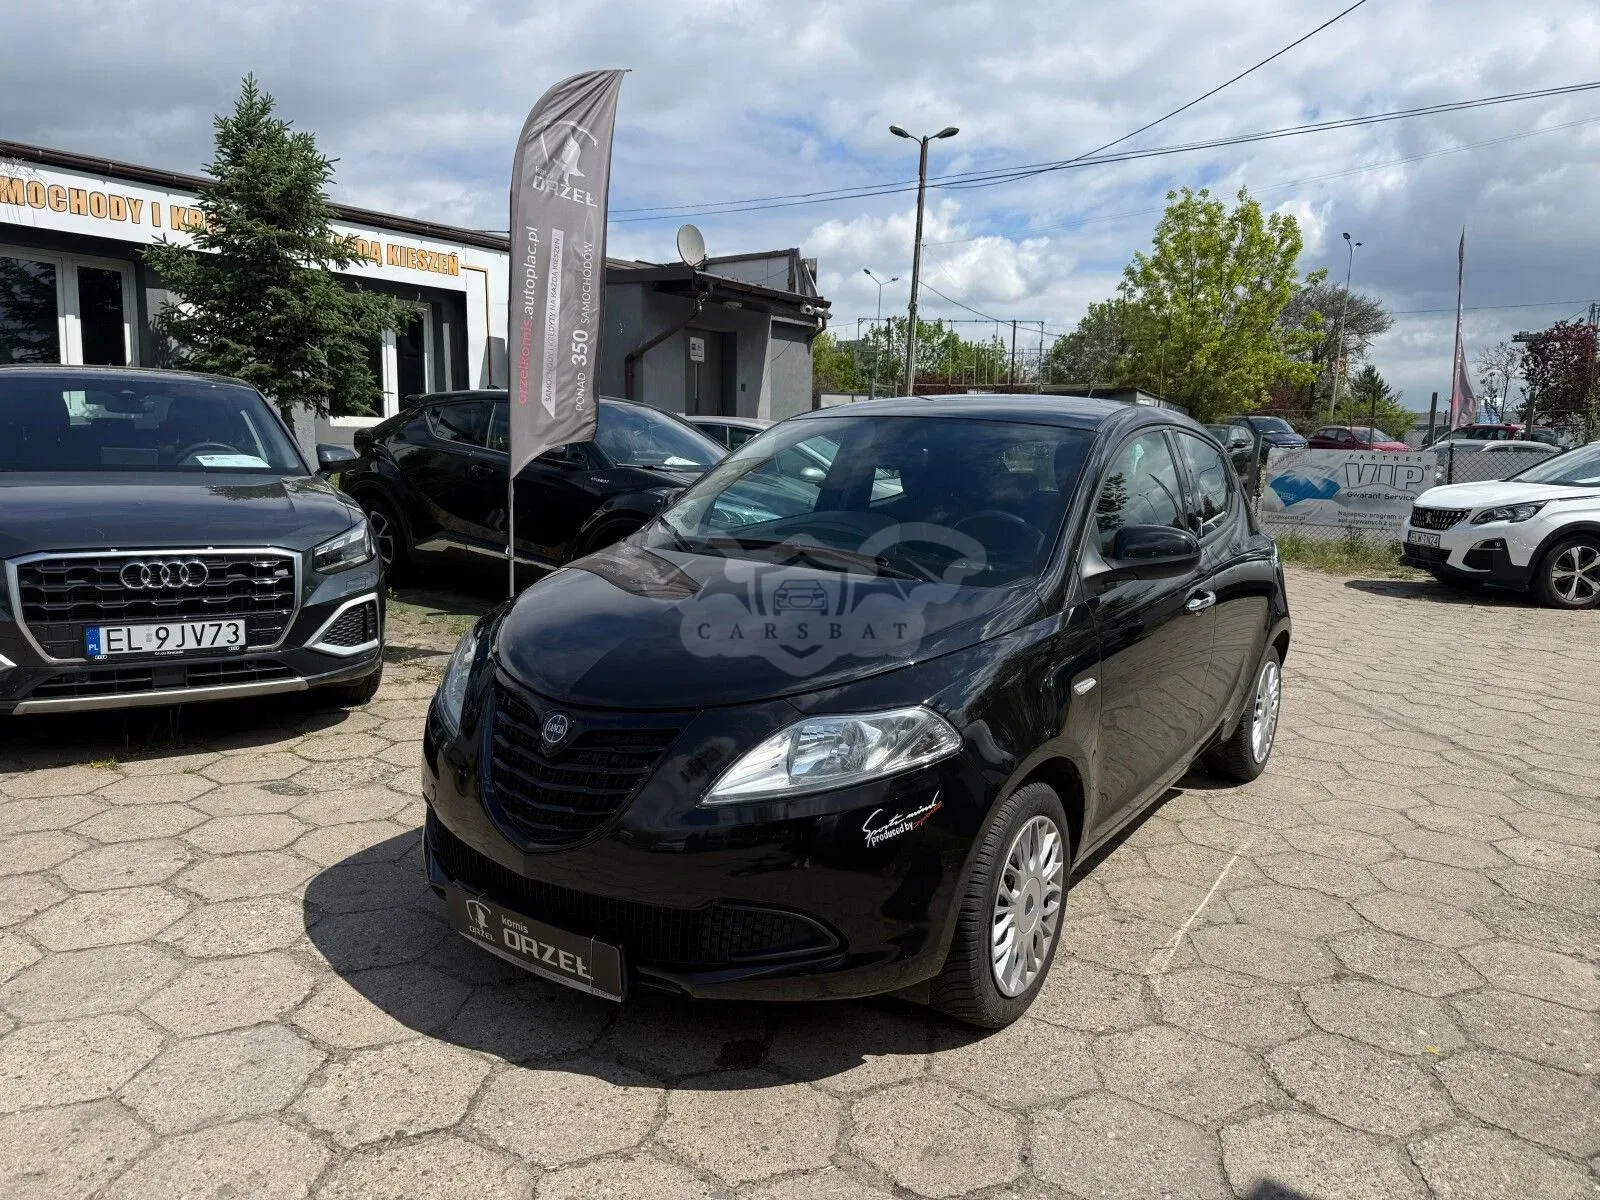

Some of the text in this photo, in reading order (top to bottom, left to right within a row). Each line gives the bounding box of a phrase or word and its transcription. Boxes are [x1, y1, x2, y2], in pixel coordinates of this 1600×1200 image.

[151, 202, 161, 227] I
[386, 243, 459, 276] KIESZEŃ
[549, 299, 556, 311] NA
[571, 241, 593, 411] PONAD 350 SAMOCHODÓW
[1349, 454, 1422, 463] PARTNER
[1345, 462, 1424, 490] VIP
[1347, 491, 1415, 501] Gwarant Service
[106, 627, 143, 652] EL
[155, 622, 240, 649] 9JV73
[871, 821, 914, 846] produced by
[501, 914, 529, 934] komis
[503, 928, 594, 980] ORZEŁ
